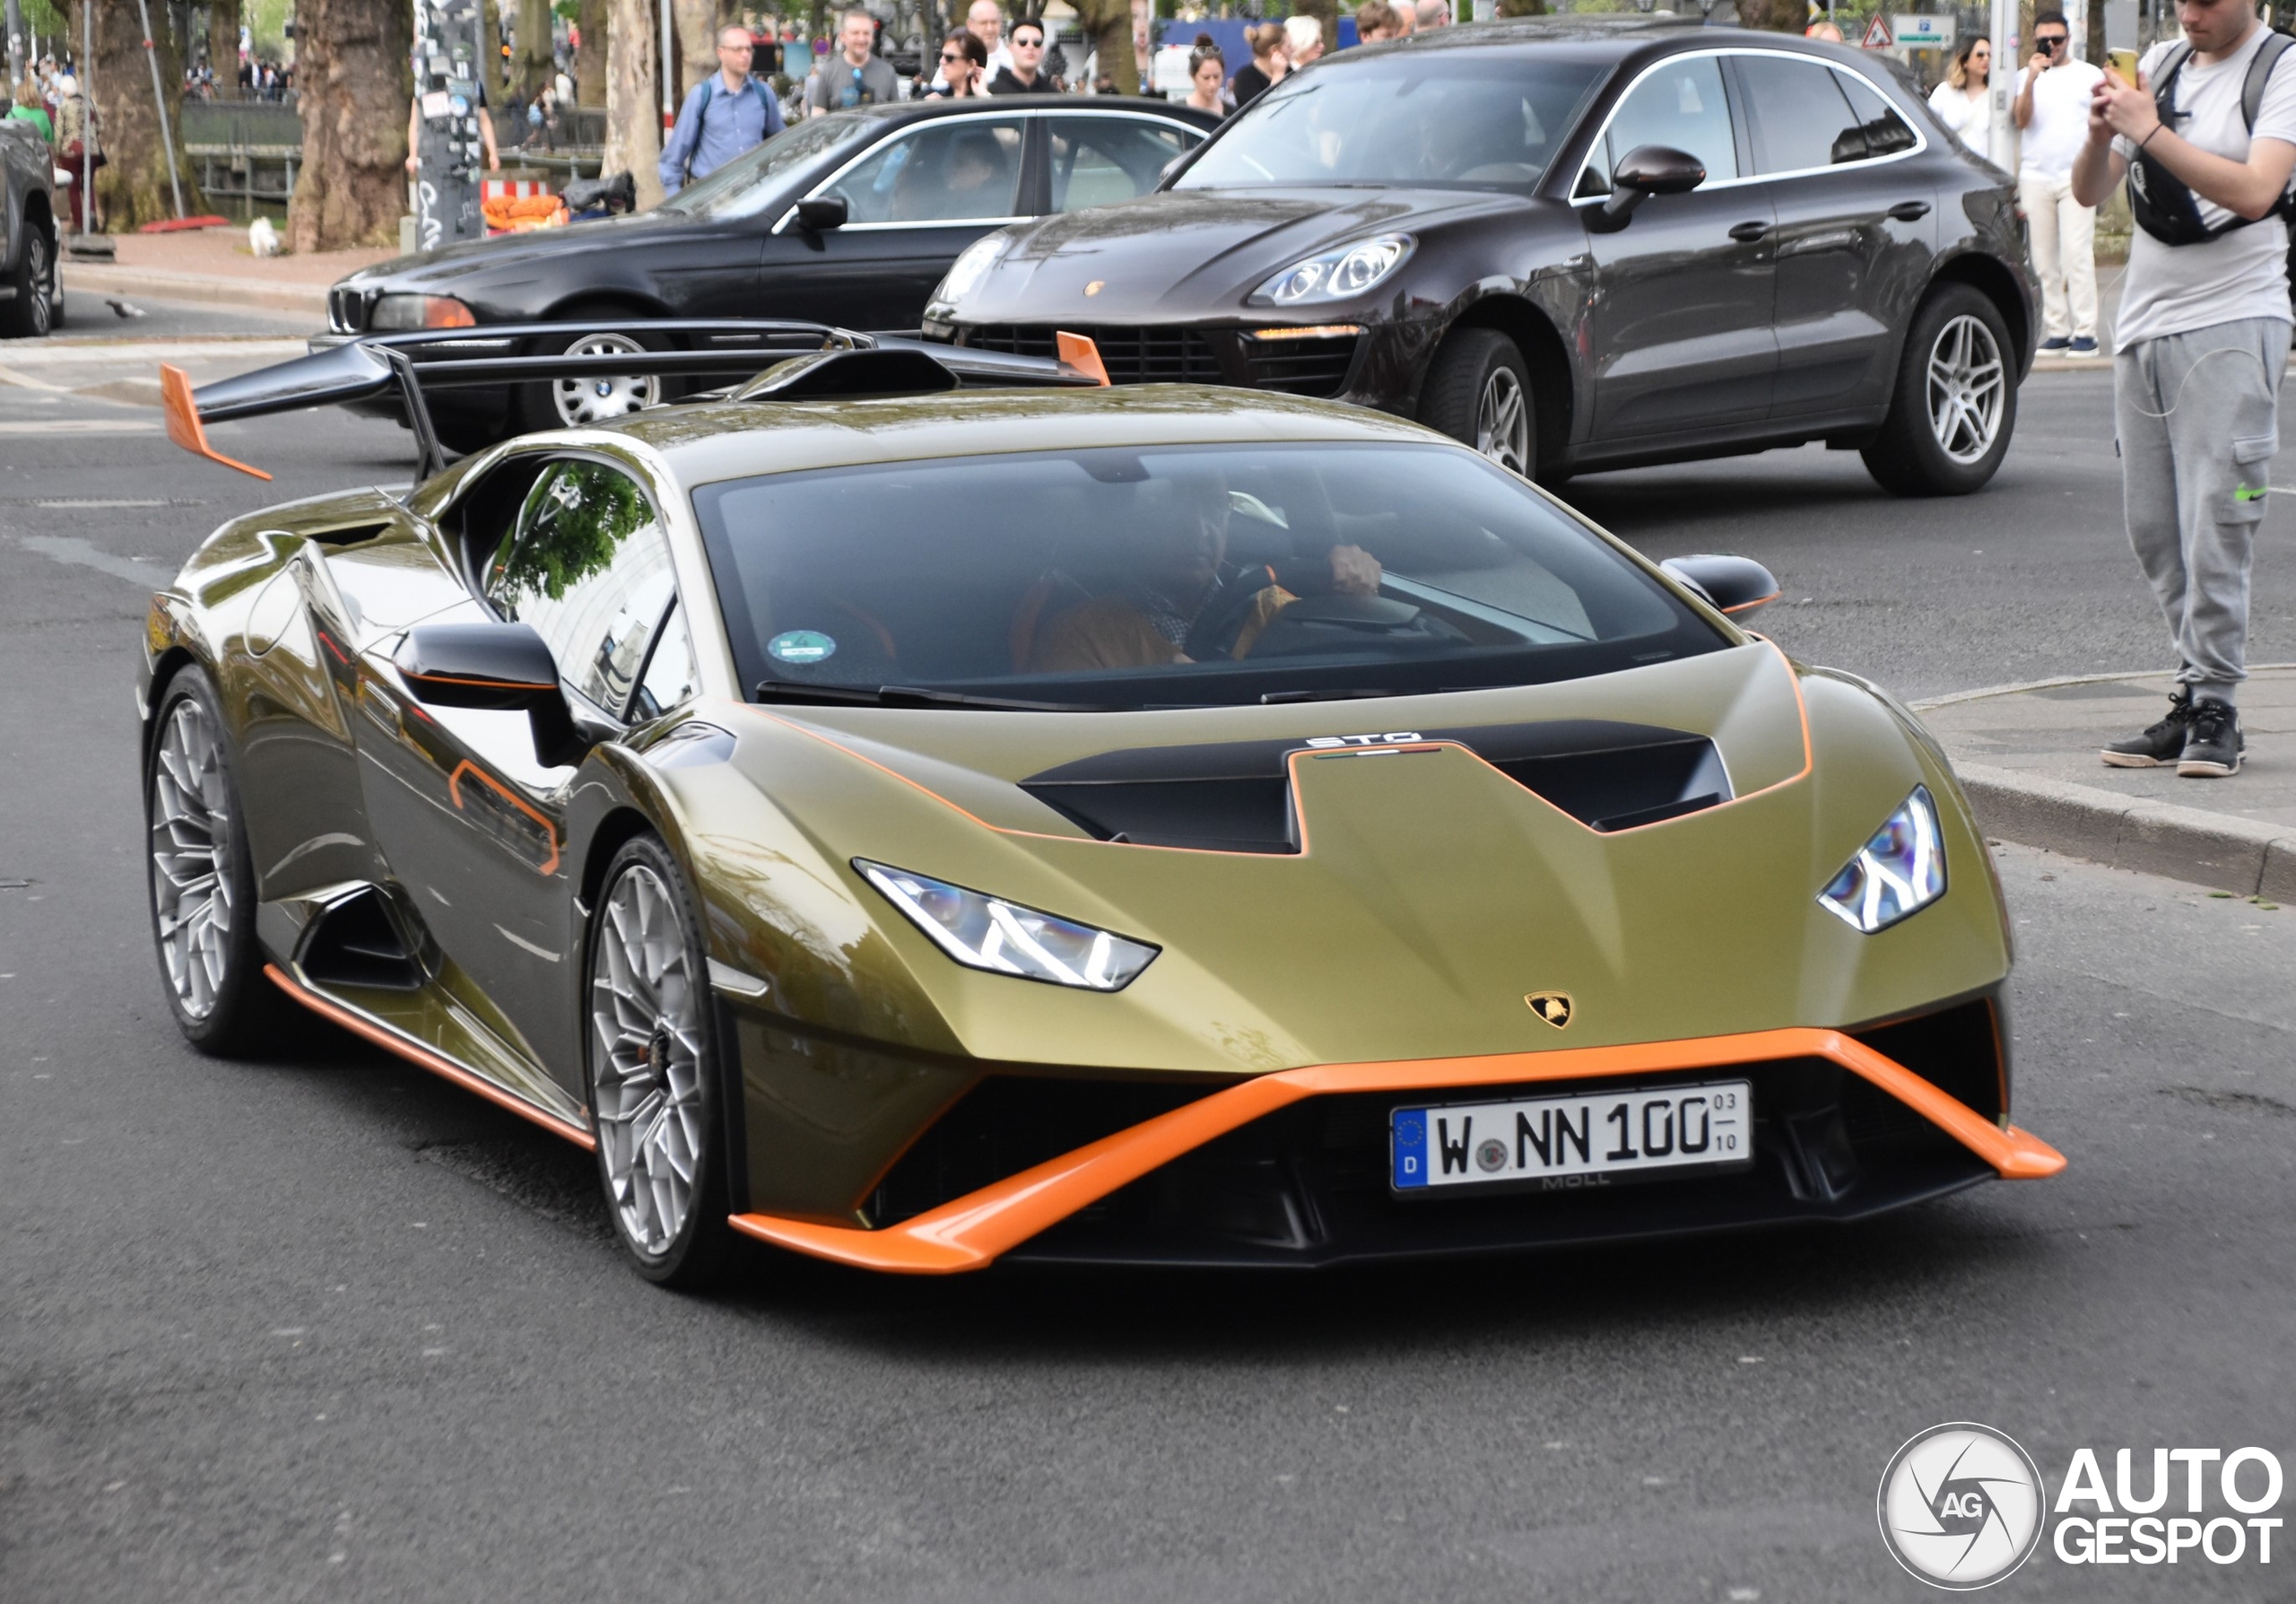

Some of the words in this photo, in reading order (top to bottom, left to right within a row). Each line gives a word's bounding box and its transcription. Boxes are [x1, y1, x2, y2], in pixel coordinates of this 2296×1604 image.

[1306, 732, 1422, 747] STO
[1714, 1094, 1736, 1111] 03
[1437, 1116, 1472, 1175] W
[1516, 1106, 1590, 1169] NN
[1606, 1096, 1709, 1161] 100
[1715, 1135, 1736, 1152] 10
[1404, 1157, 1417, 1173] D
[1542, 1172, 1611, 1190] MOLL
